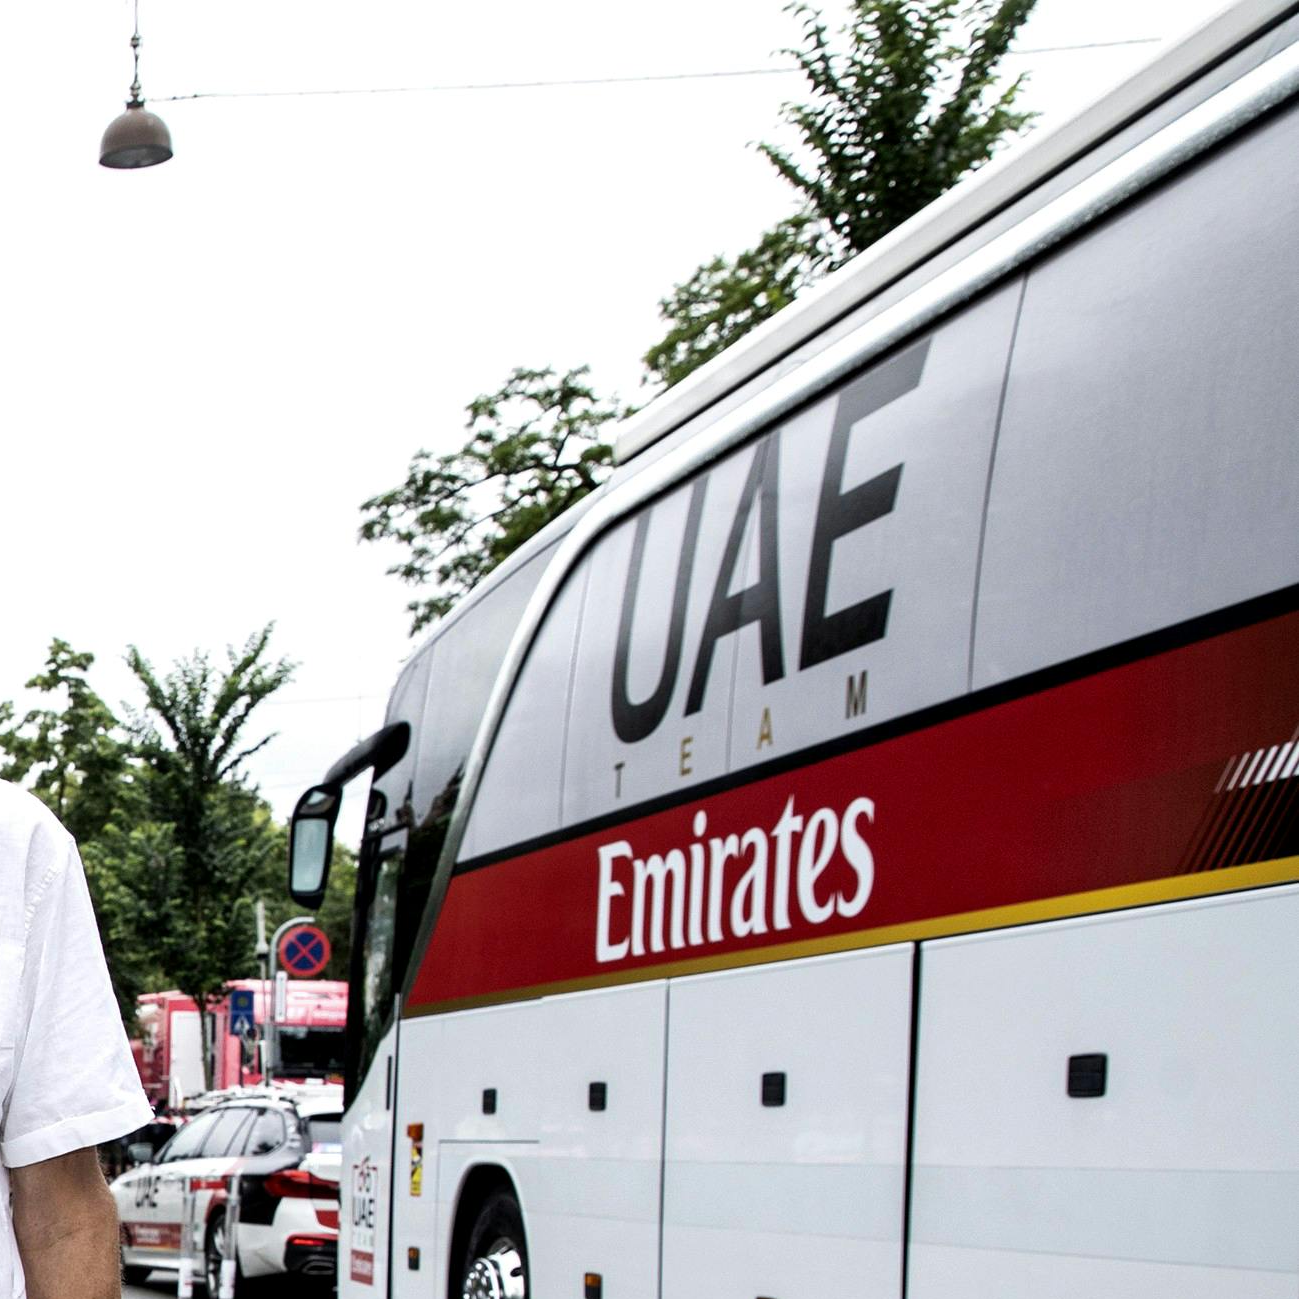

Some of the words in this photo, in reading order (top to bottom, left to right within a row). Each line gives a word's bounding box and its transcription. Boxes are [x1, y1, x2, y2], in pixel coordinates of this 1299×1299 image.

[610, 334, 933, 745] UAE
[612, 669, 869, 800] TEAM
[594, 794, 875, 963] Emirates
